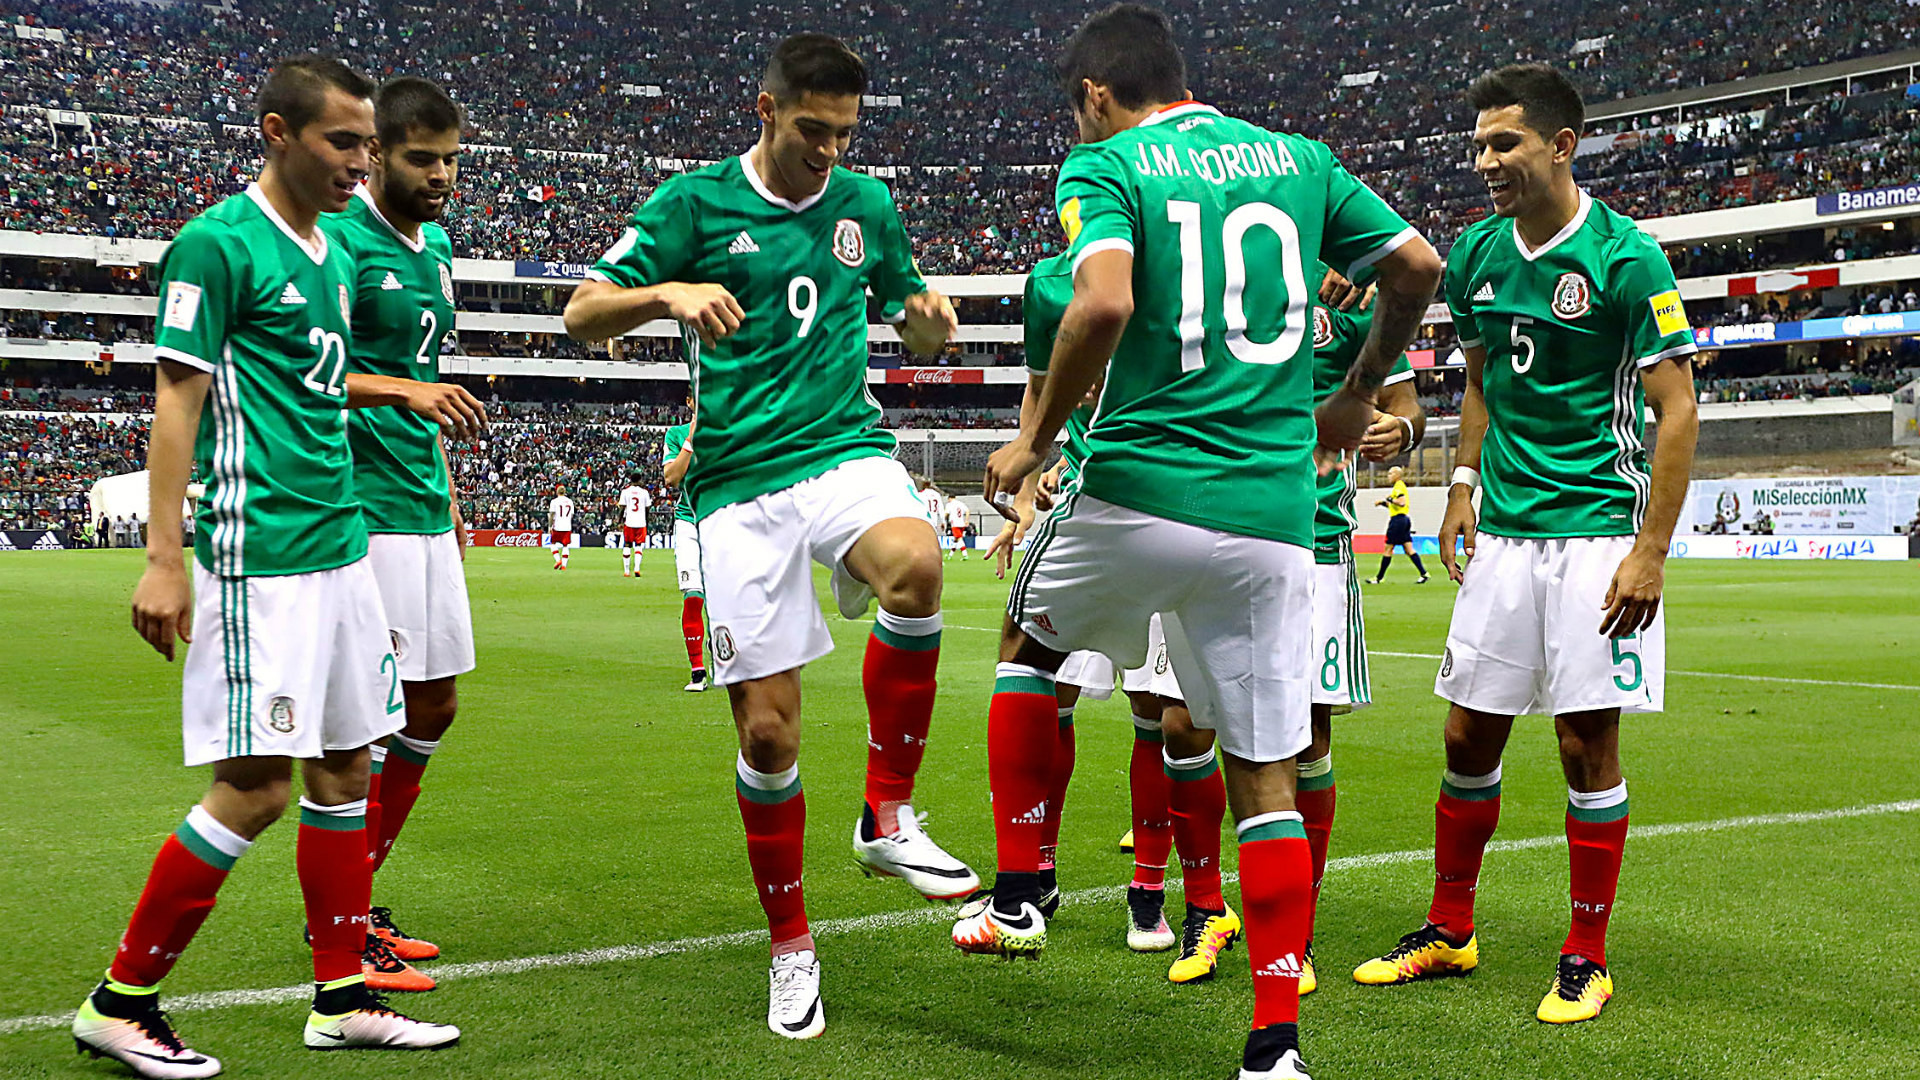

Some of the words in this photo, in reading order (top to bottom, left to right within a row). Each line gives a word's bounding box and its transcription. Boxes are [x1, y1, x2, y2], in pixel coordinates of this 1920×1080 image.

[1135, 142, 1190, 177] J.M.
[1188, 140, 1299, 185] CORONA
[561, 263, 592, 276] QUAK
[1167, 199, 1308, 373] 10
[788, 276, 818, 338] 9
[1656, 304, 1677, 317] FIFA
[304, 327, 347, 396] 22
[416, 310, 437, 364] 2
[1510, 316, 1536, 374] 5
[559, 505, 572, 518] 17
[631, 497, 640, 512] 3
[928, 499, 938, 513] 13
[1753, 488, 1868, 505] MiSelecciónMX
[1321, 636, 1340, 692] 8
[1610, 632, 1643, 692] 5
